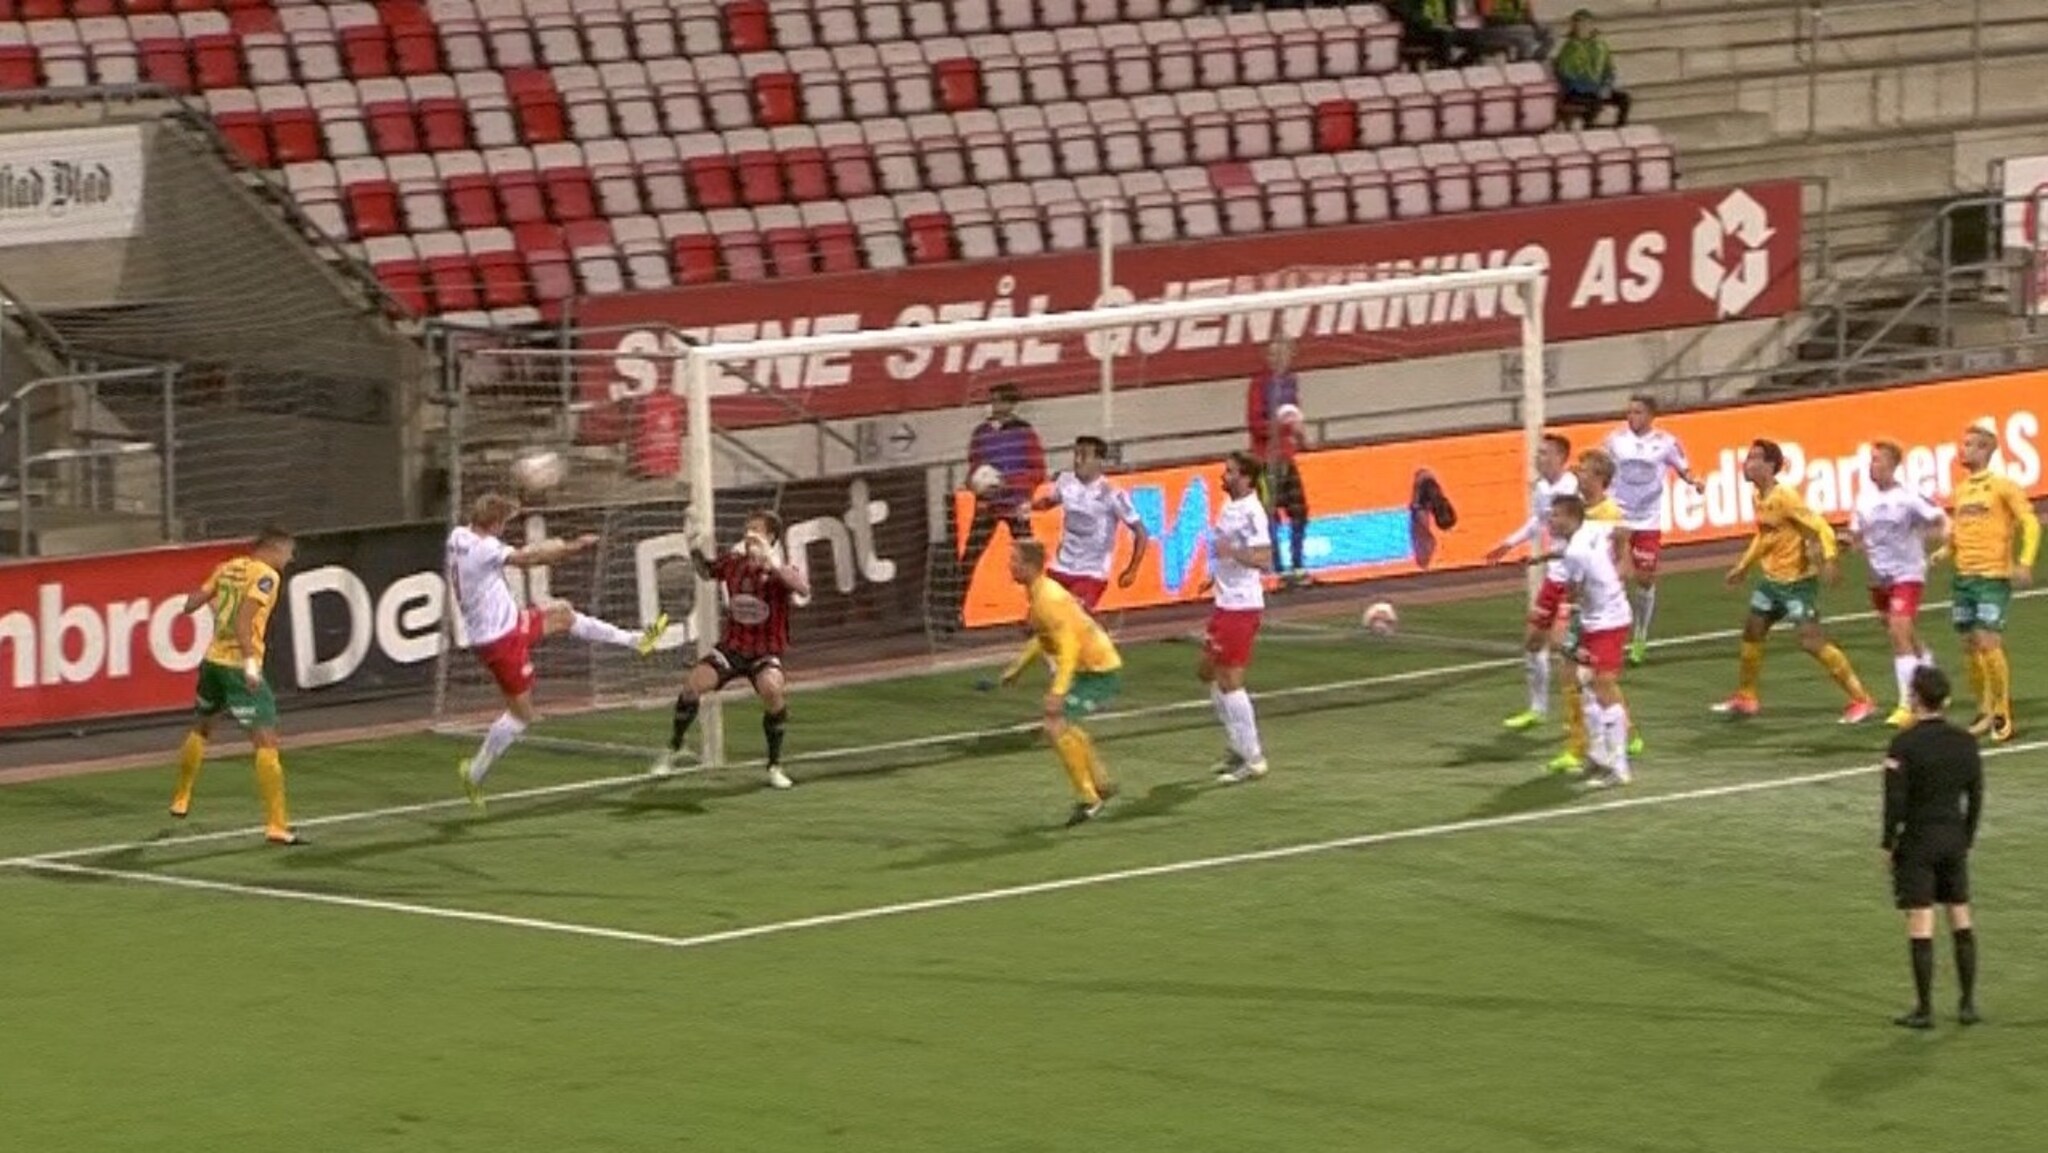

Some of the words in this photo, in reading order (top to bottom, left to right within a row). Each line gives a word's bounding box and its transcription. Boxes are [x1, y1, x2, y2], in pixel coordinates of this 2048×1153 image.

[48, 160, 112, 216] Blad
[608, 313, 861, 403] STENE
[884, 274, 1062, 380] STÅL
[1570, 230, 1668, 308] AS
